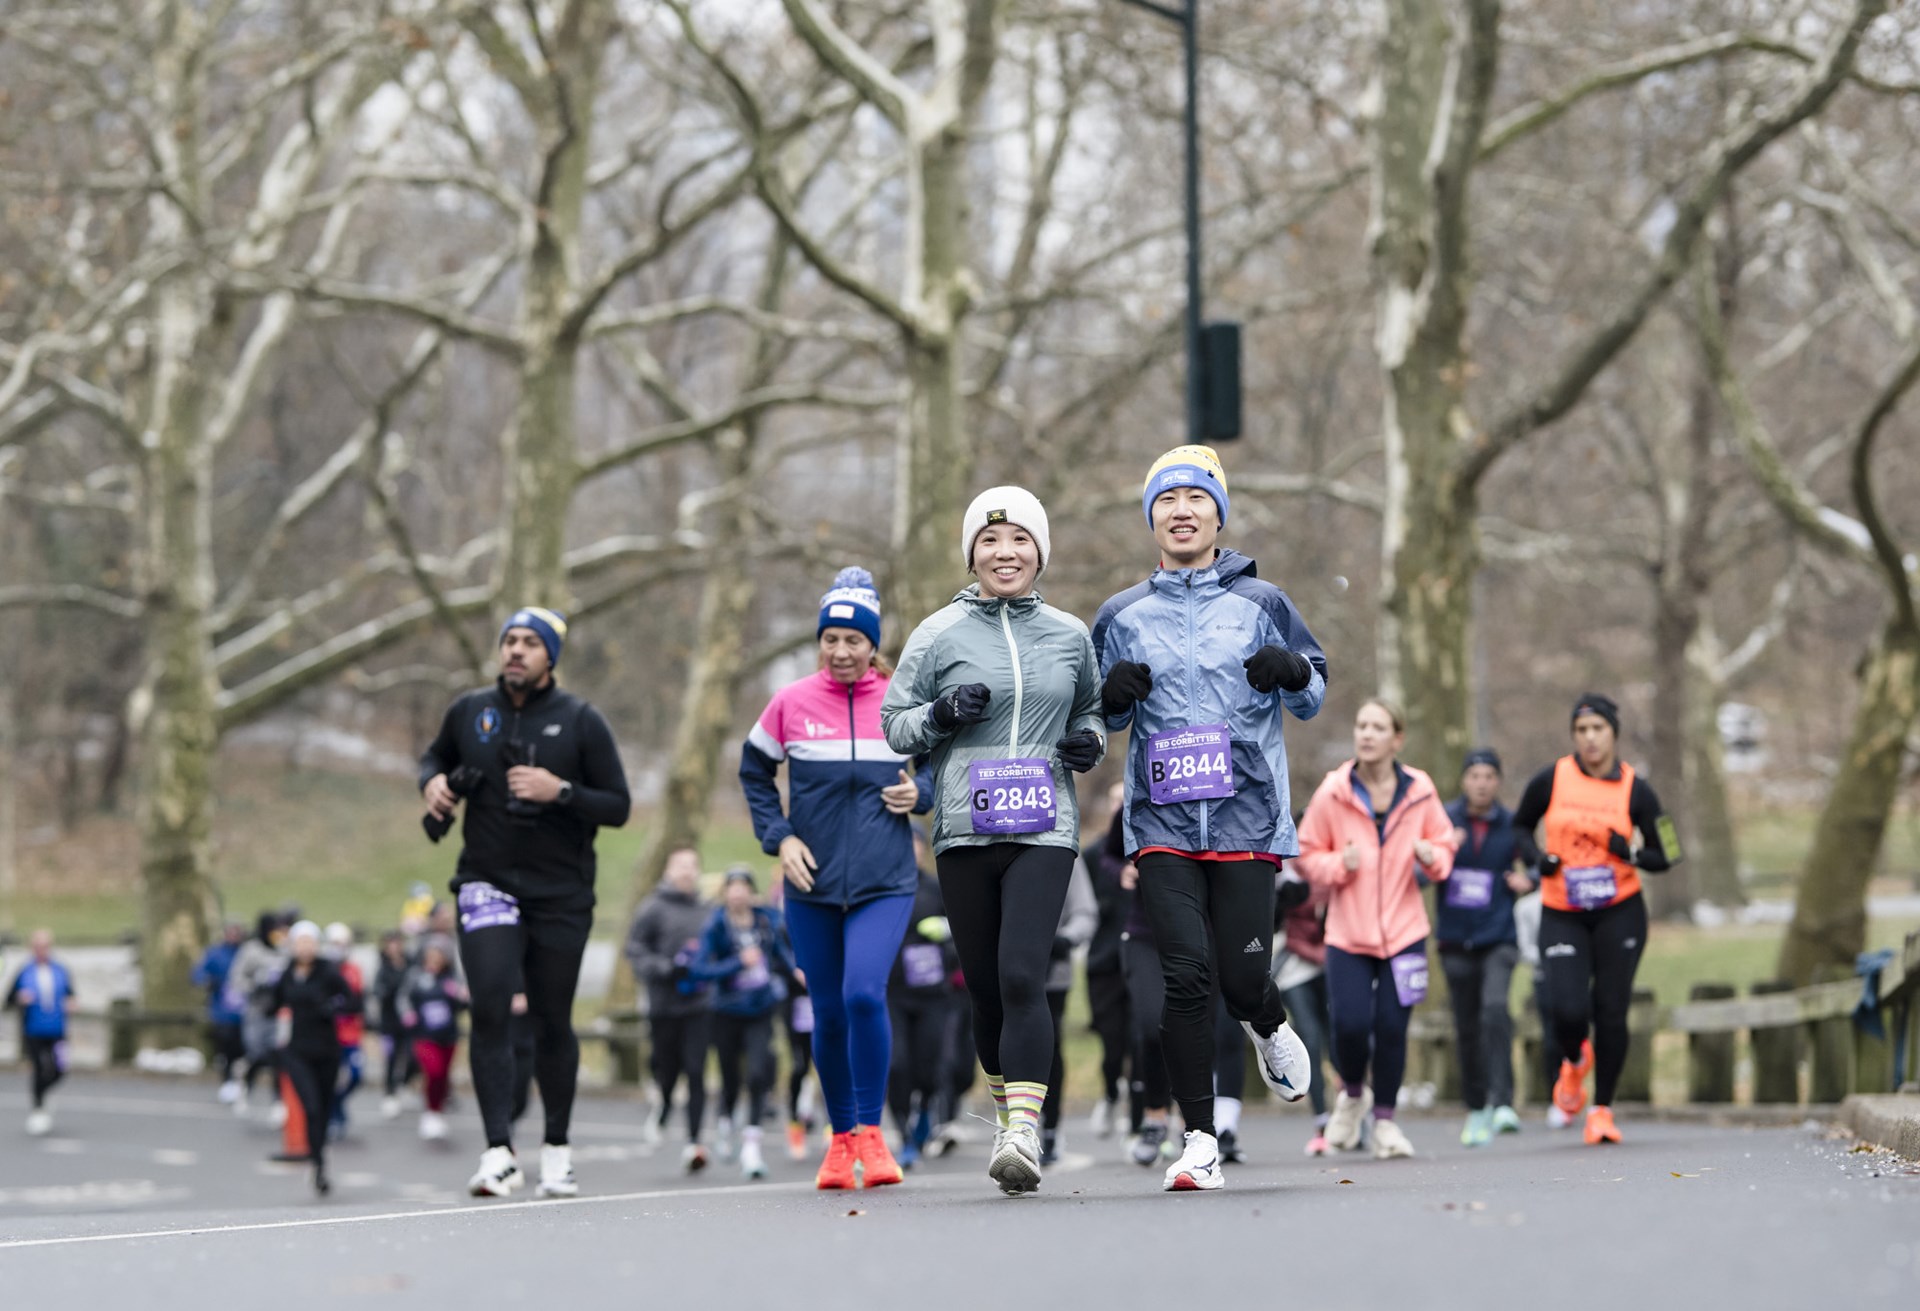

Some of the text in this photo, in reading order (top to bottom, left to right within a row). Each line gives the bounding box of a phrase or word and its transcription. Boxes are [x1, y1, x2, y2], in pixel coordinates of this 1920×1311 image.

[1155, 741, 1170, 749] TED
[978, 770, 995, 778] TED
[1151, 752, 1227, 783] B 2844
[973, 786, 1052, 811] G 2843
